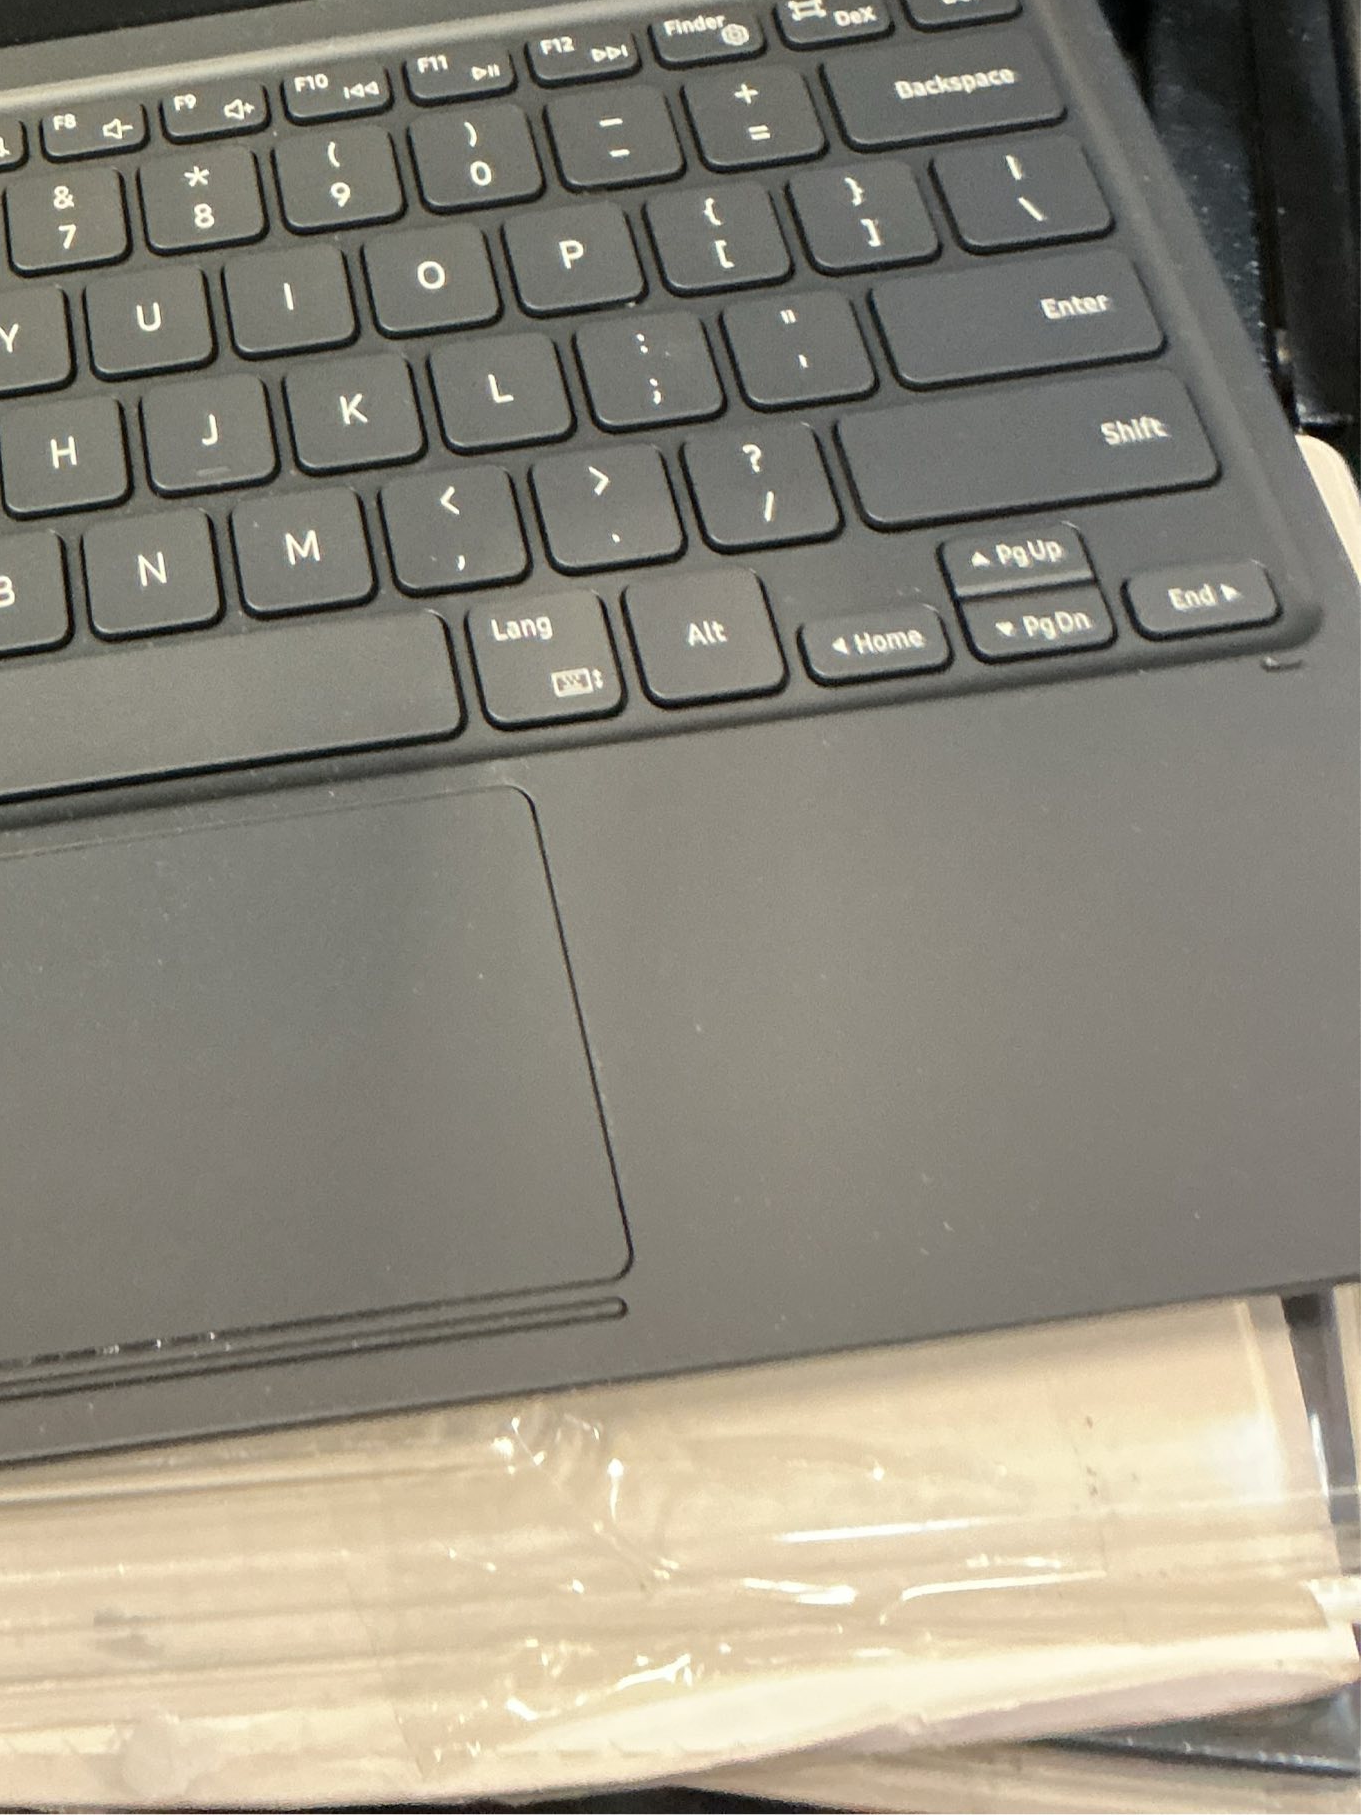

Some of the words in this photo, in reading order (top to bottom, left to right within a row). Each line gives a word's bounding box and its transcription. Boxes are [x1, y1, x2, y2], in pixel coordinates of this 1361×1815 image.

[663, 15, 725, 36] Finder
[832, 6, 877, 27] DeX
[539, 36, 575, 56] F12
[416, 54, 449, 74] F11
[293, 73, 329, 93] F10
[733, 83, 759, 104] +
[894, 68, 1015, 100] Backspace
[173, 93, 197, 112] F9
[52, 113, 77, 131] F8
[463, 121, 478, 148] )
[747, 124, 771, 141] =
[327, 141, 341, 168] (
[469, 160, 492, 187] 0
[53, 185, 75, 210] &
[329, 182, 351, 208] 9
[845, 177, 863, 207] }
[193, 203, 215, 229] 8
[702, 197, 722, 226] {
[58, 223, 77, 250] 7
[860, 218, 881, 248] ]
[558, 239, 584, 270] P
[713, 239, 735, 269] [
[417, 260, 446, 290] O
[135, 301, 162, 332] U
[1040, 294, 1109, 320] Enter
[636, 333, 649, 354] :
[487, 373, 515, 404] L
[649, 378, 662, 405] ;
[339, 393, 368, 425] K
[201, 413, 218, 447] J
[1100, 416, 1169, 446] Shift
[50, 435, 78, 469] H
[742, 444, 762, 473] ?
[588, 466, 610, 496] >
[439, 486, 460, 515] <
[763, 491, 775, 523] /
[284, 529, 321, 566] M
[995, 539, 1063, 568] PgUp
[137, 551, 168, 587] N
[1167, 583, 1217, 612] End
[490, 616, 553, 642] Lang
[687, 620, 728, 647] Alt
[1022, 611, 1093, 641] PgDn
[853, 629, 925, 655] Home
